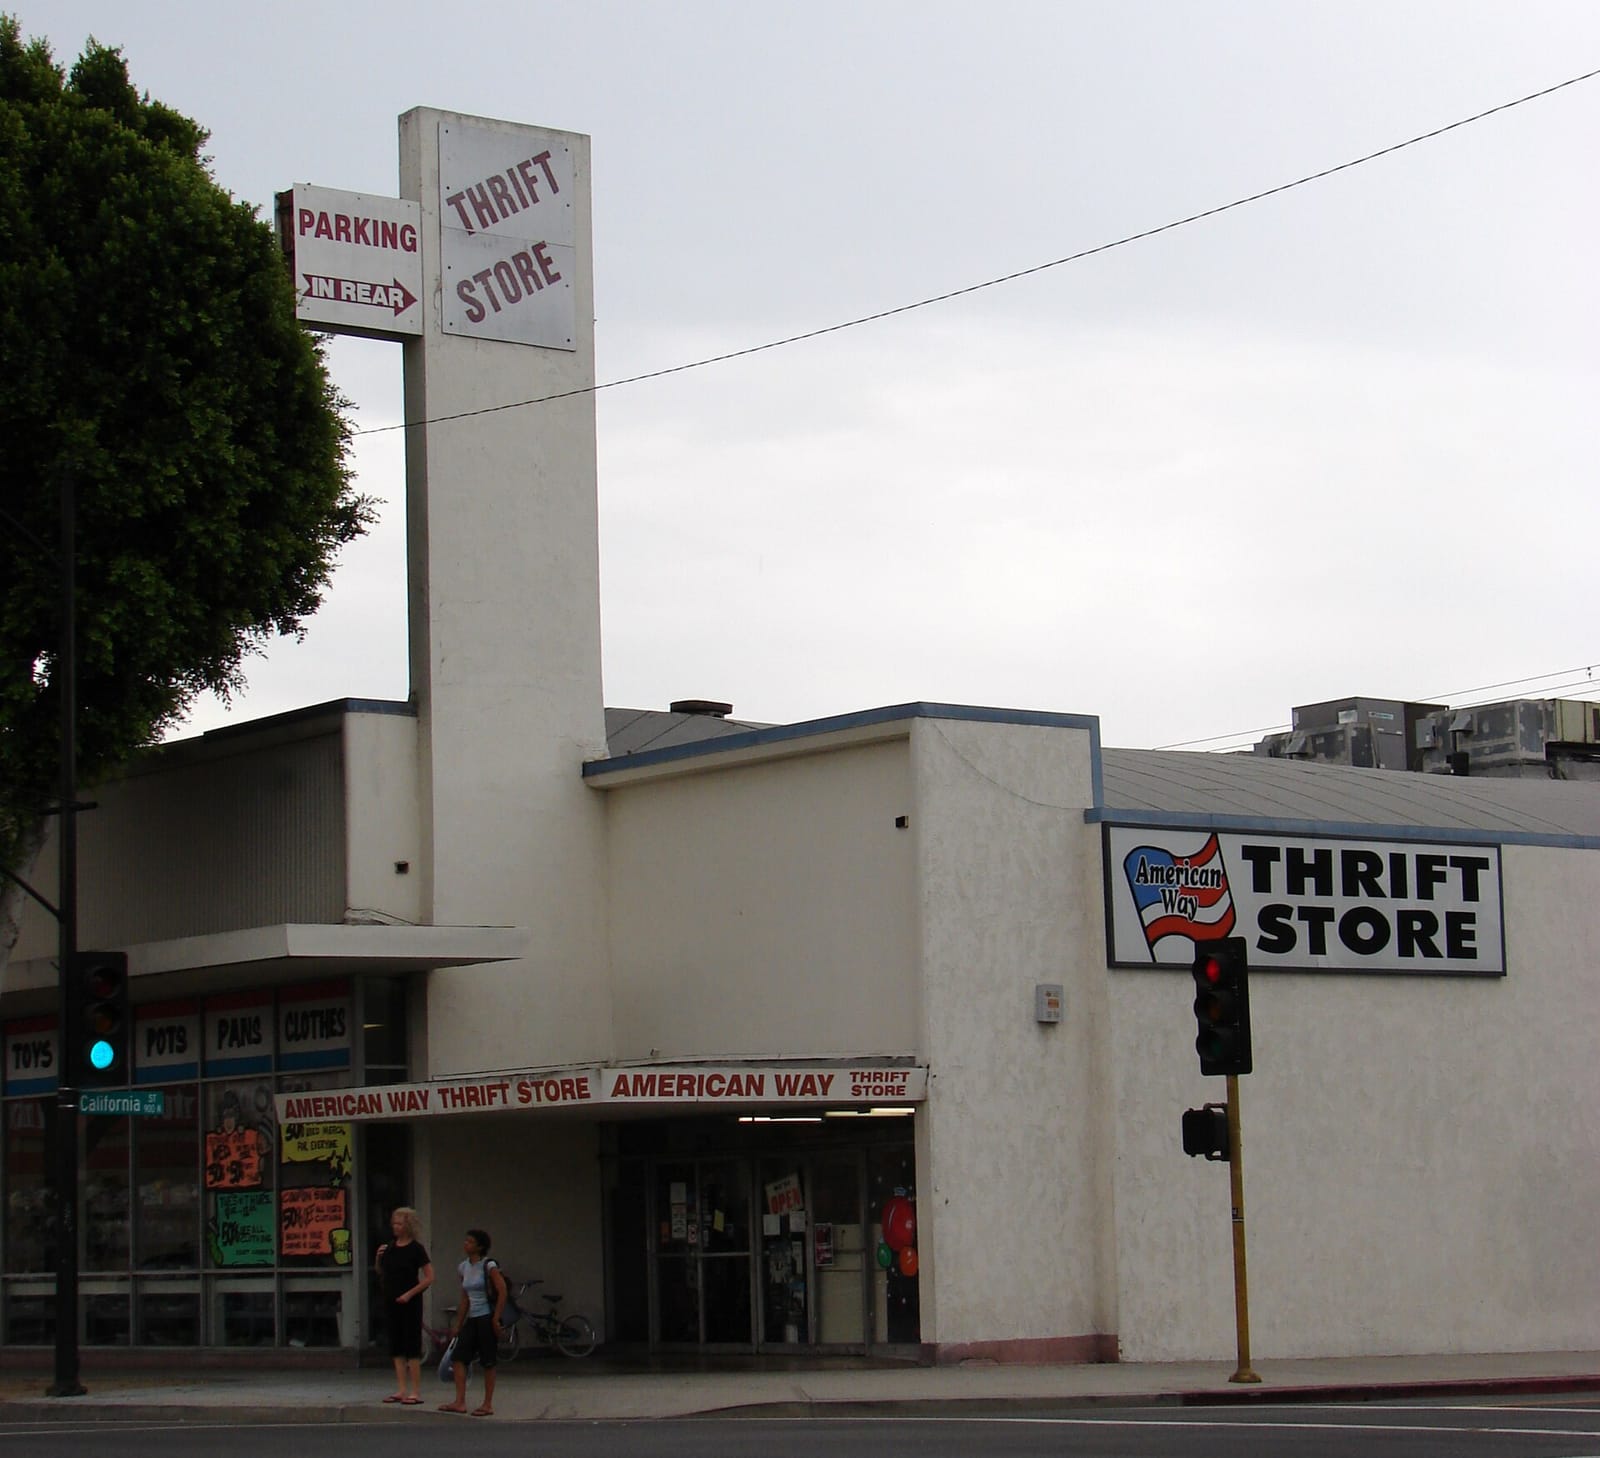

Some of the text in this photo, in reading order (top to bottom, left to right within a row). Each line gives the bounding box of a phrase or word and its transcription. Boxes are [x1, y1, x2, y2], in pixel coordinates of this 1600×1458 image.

[446, 150, 559, 236] THRIFT
[299, 208, 417, 253] PARKING
[311, 277, 405, 308] IN REAR
[456, 241, 562, 324] STORE
[1135, 856, 1223, 891] American
[1241, 844, 1490, 902] THRIFT
[1160, 887, 1199, 921] Way
[1256, 903, 1478, 960] STORE
[147, 1025, 187, 1057] POTS
[218, 1016, 262, 1049] PANS
[285, 1007, 346, 1043] CLOTHES
[12, 1039, 53, 1070] TOYS
[611, 1073, 835, 1097] AMERICAN WAY
[849, 1071, 910, 1083] THRIFT
[851, 1084, 906, 1097] STORE
[80, 1094, 141, 1112] California
[148, 1094, 157, 1103] ST
[285, 1092, 384, 1119] AMERICAN
[387, 1088, 430, 1113] WAY
[437, 1082, 511, 1108] THRIFT
[516, 1076, 592, 1104] STORE
[770, 1187, 801, 1214] OPEN
